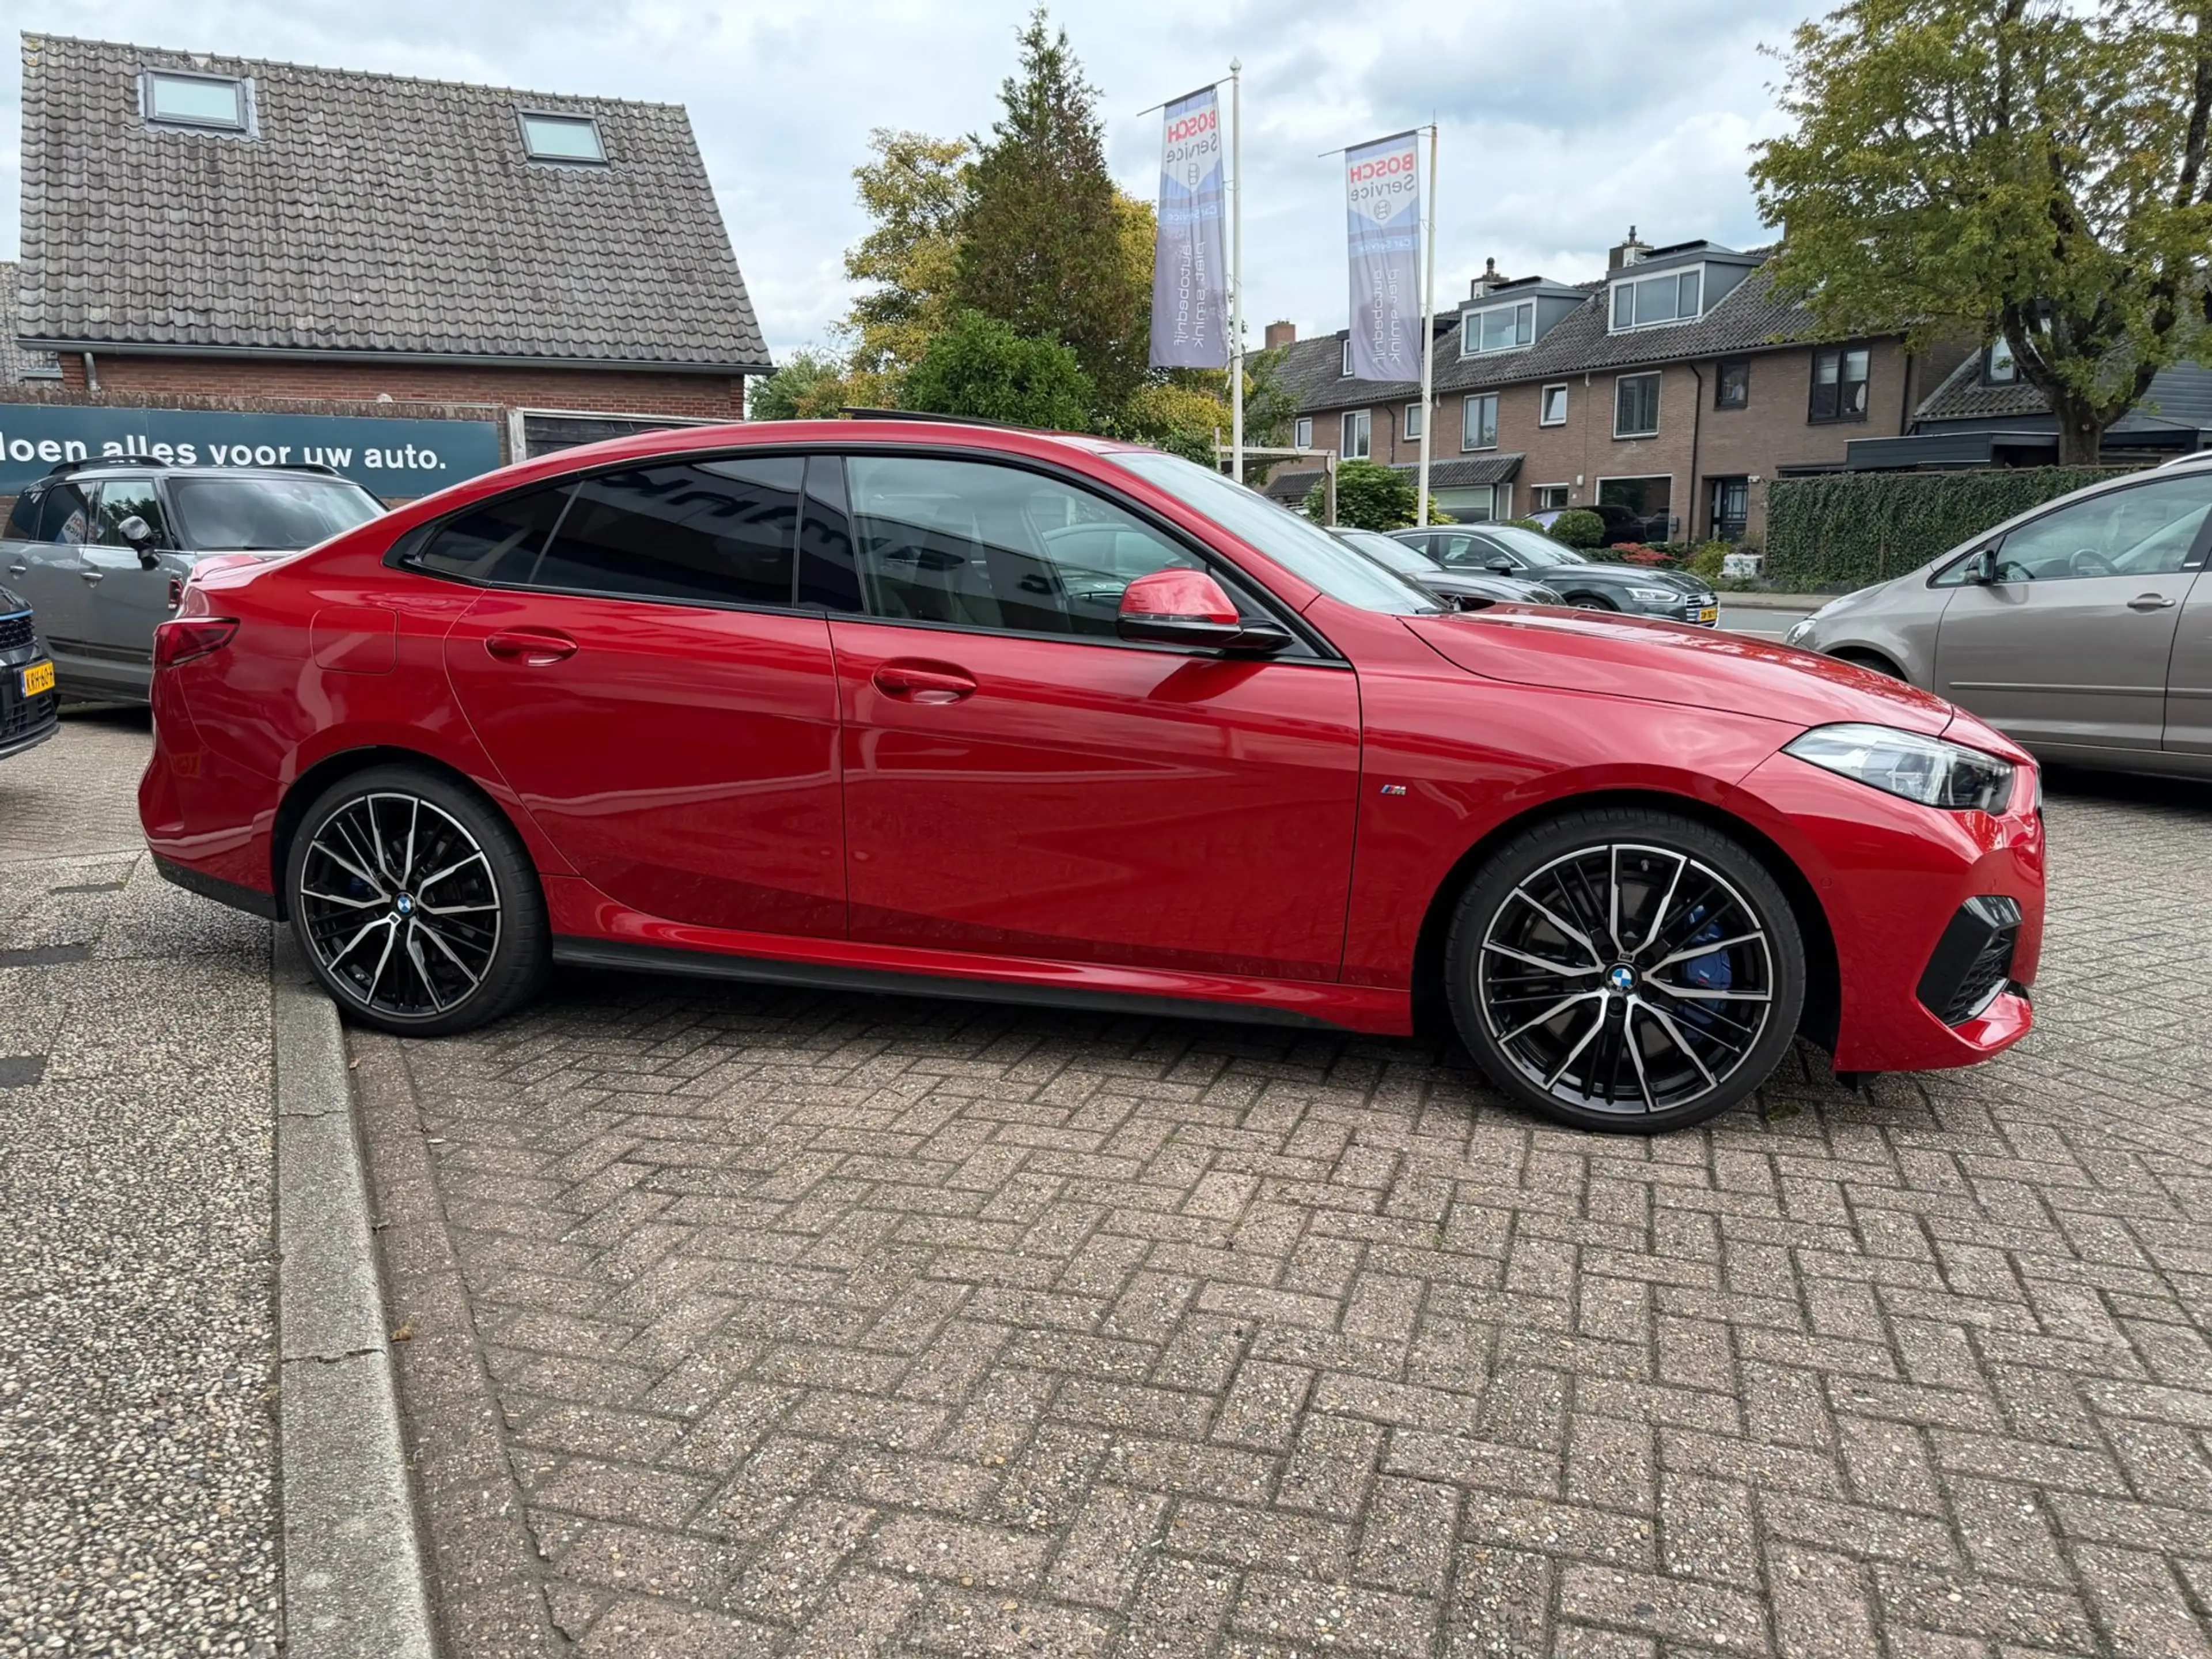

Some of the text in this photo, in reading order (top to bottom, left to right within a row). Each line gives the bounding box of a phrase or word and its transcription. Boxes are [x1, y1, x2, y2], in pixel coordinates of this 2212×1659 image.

[0, 431, 446, 469] oen alles voor uw auto.
